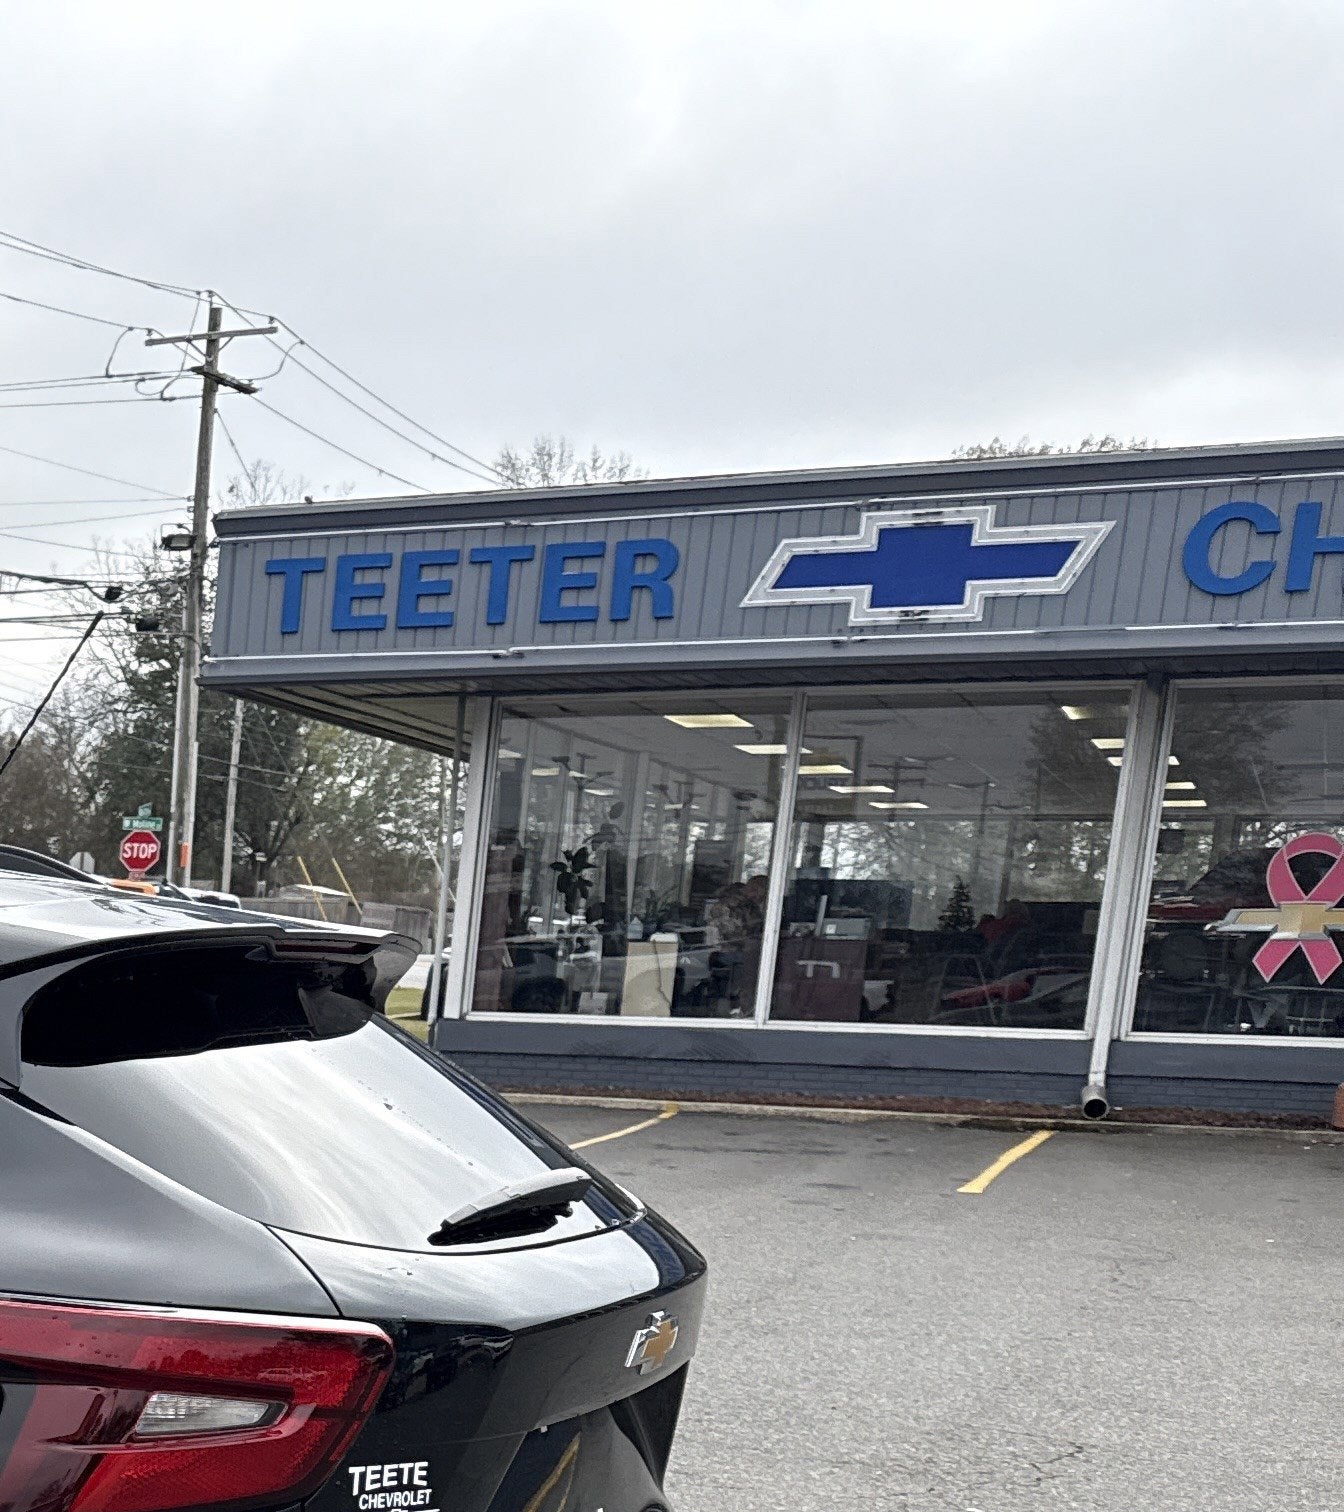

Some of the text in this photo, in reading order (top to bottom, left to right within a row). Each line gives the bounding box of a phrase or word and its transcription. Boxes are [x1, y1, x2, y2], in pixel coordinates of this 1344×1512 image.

[265, 538, 679, 635] TEETER
[122, 842, 158, 859] STOP
[348, 1461, 429, 1496] TEETE
[358, 1488, 433, 1510] CHEVROLET
